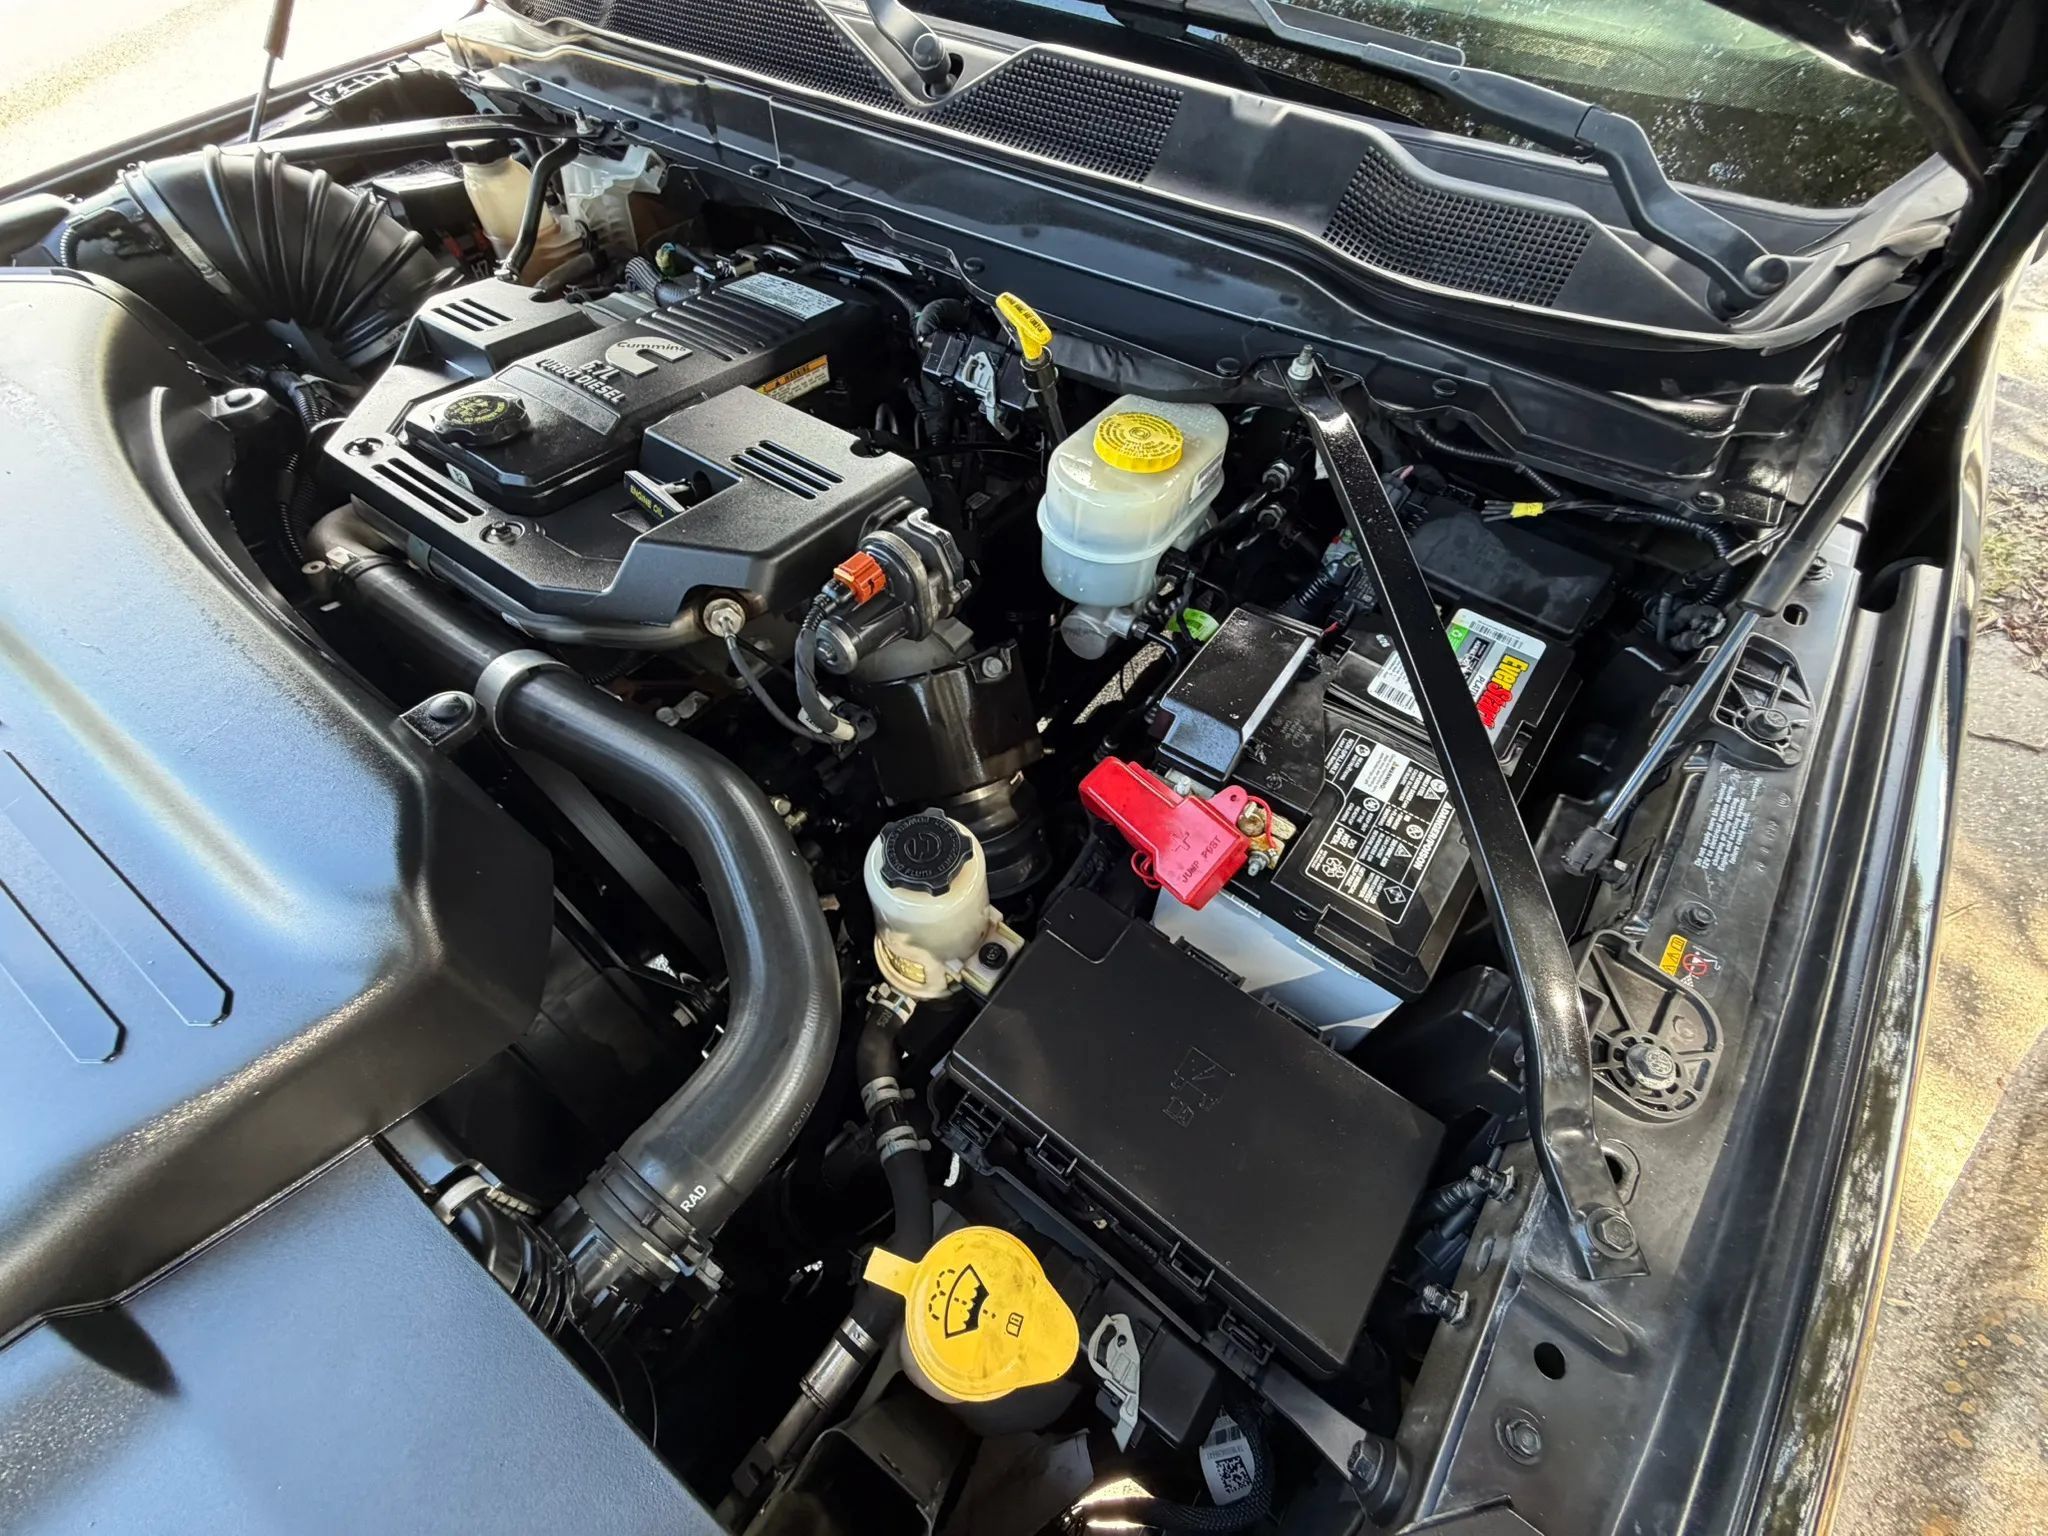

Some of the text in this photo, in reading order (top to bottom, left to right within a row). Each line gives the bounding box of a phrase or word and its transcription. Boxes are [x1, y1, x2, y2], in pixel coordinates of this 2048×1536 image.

[616, 340, 687, 352] Cummins
[580, 359, 620, 382] 6.7L
[574, 374, 628, 404] DIESEL
[629, 484, 665, 518] ENGINE OIL
[1328, 738, 1355, 775] NON-SPILLABLE
[1339, 833, 1351, 848] NOT
[1347, 838, 1357, 849] DO
[1413, 806, 1450, 870] DANGER/POISON
[1182, 836, 1222, 883] JUMP POST
[680, 1185, 707, 1213] RAD
